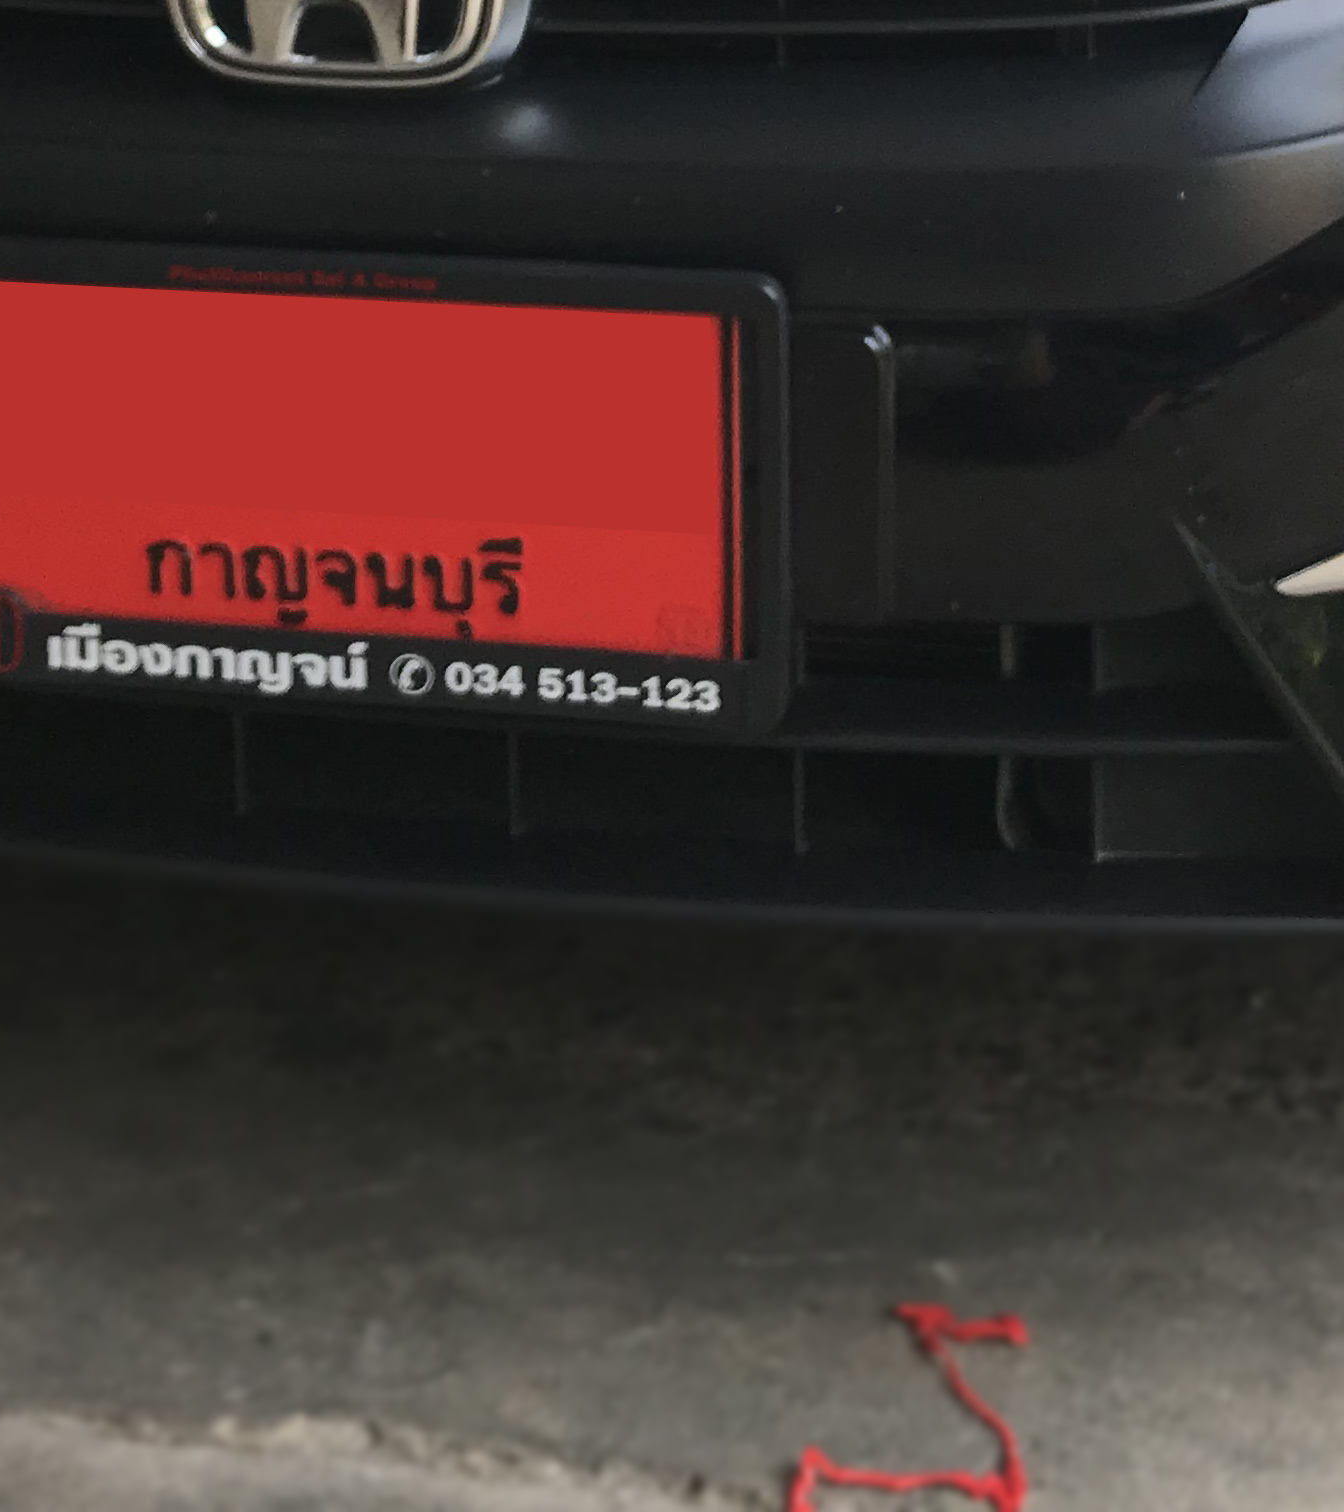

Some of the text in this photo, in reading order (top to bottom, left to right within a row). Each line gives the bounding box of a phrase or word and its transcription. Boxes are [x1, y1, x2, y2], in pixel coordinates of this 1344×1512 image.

[146, 537, 524, 641] กาญจนบุรี
[46, 622, 722, 714] เมืองกาญจน์ 034 513-123
